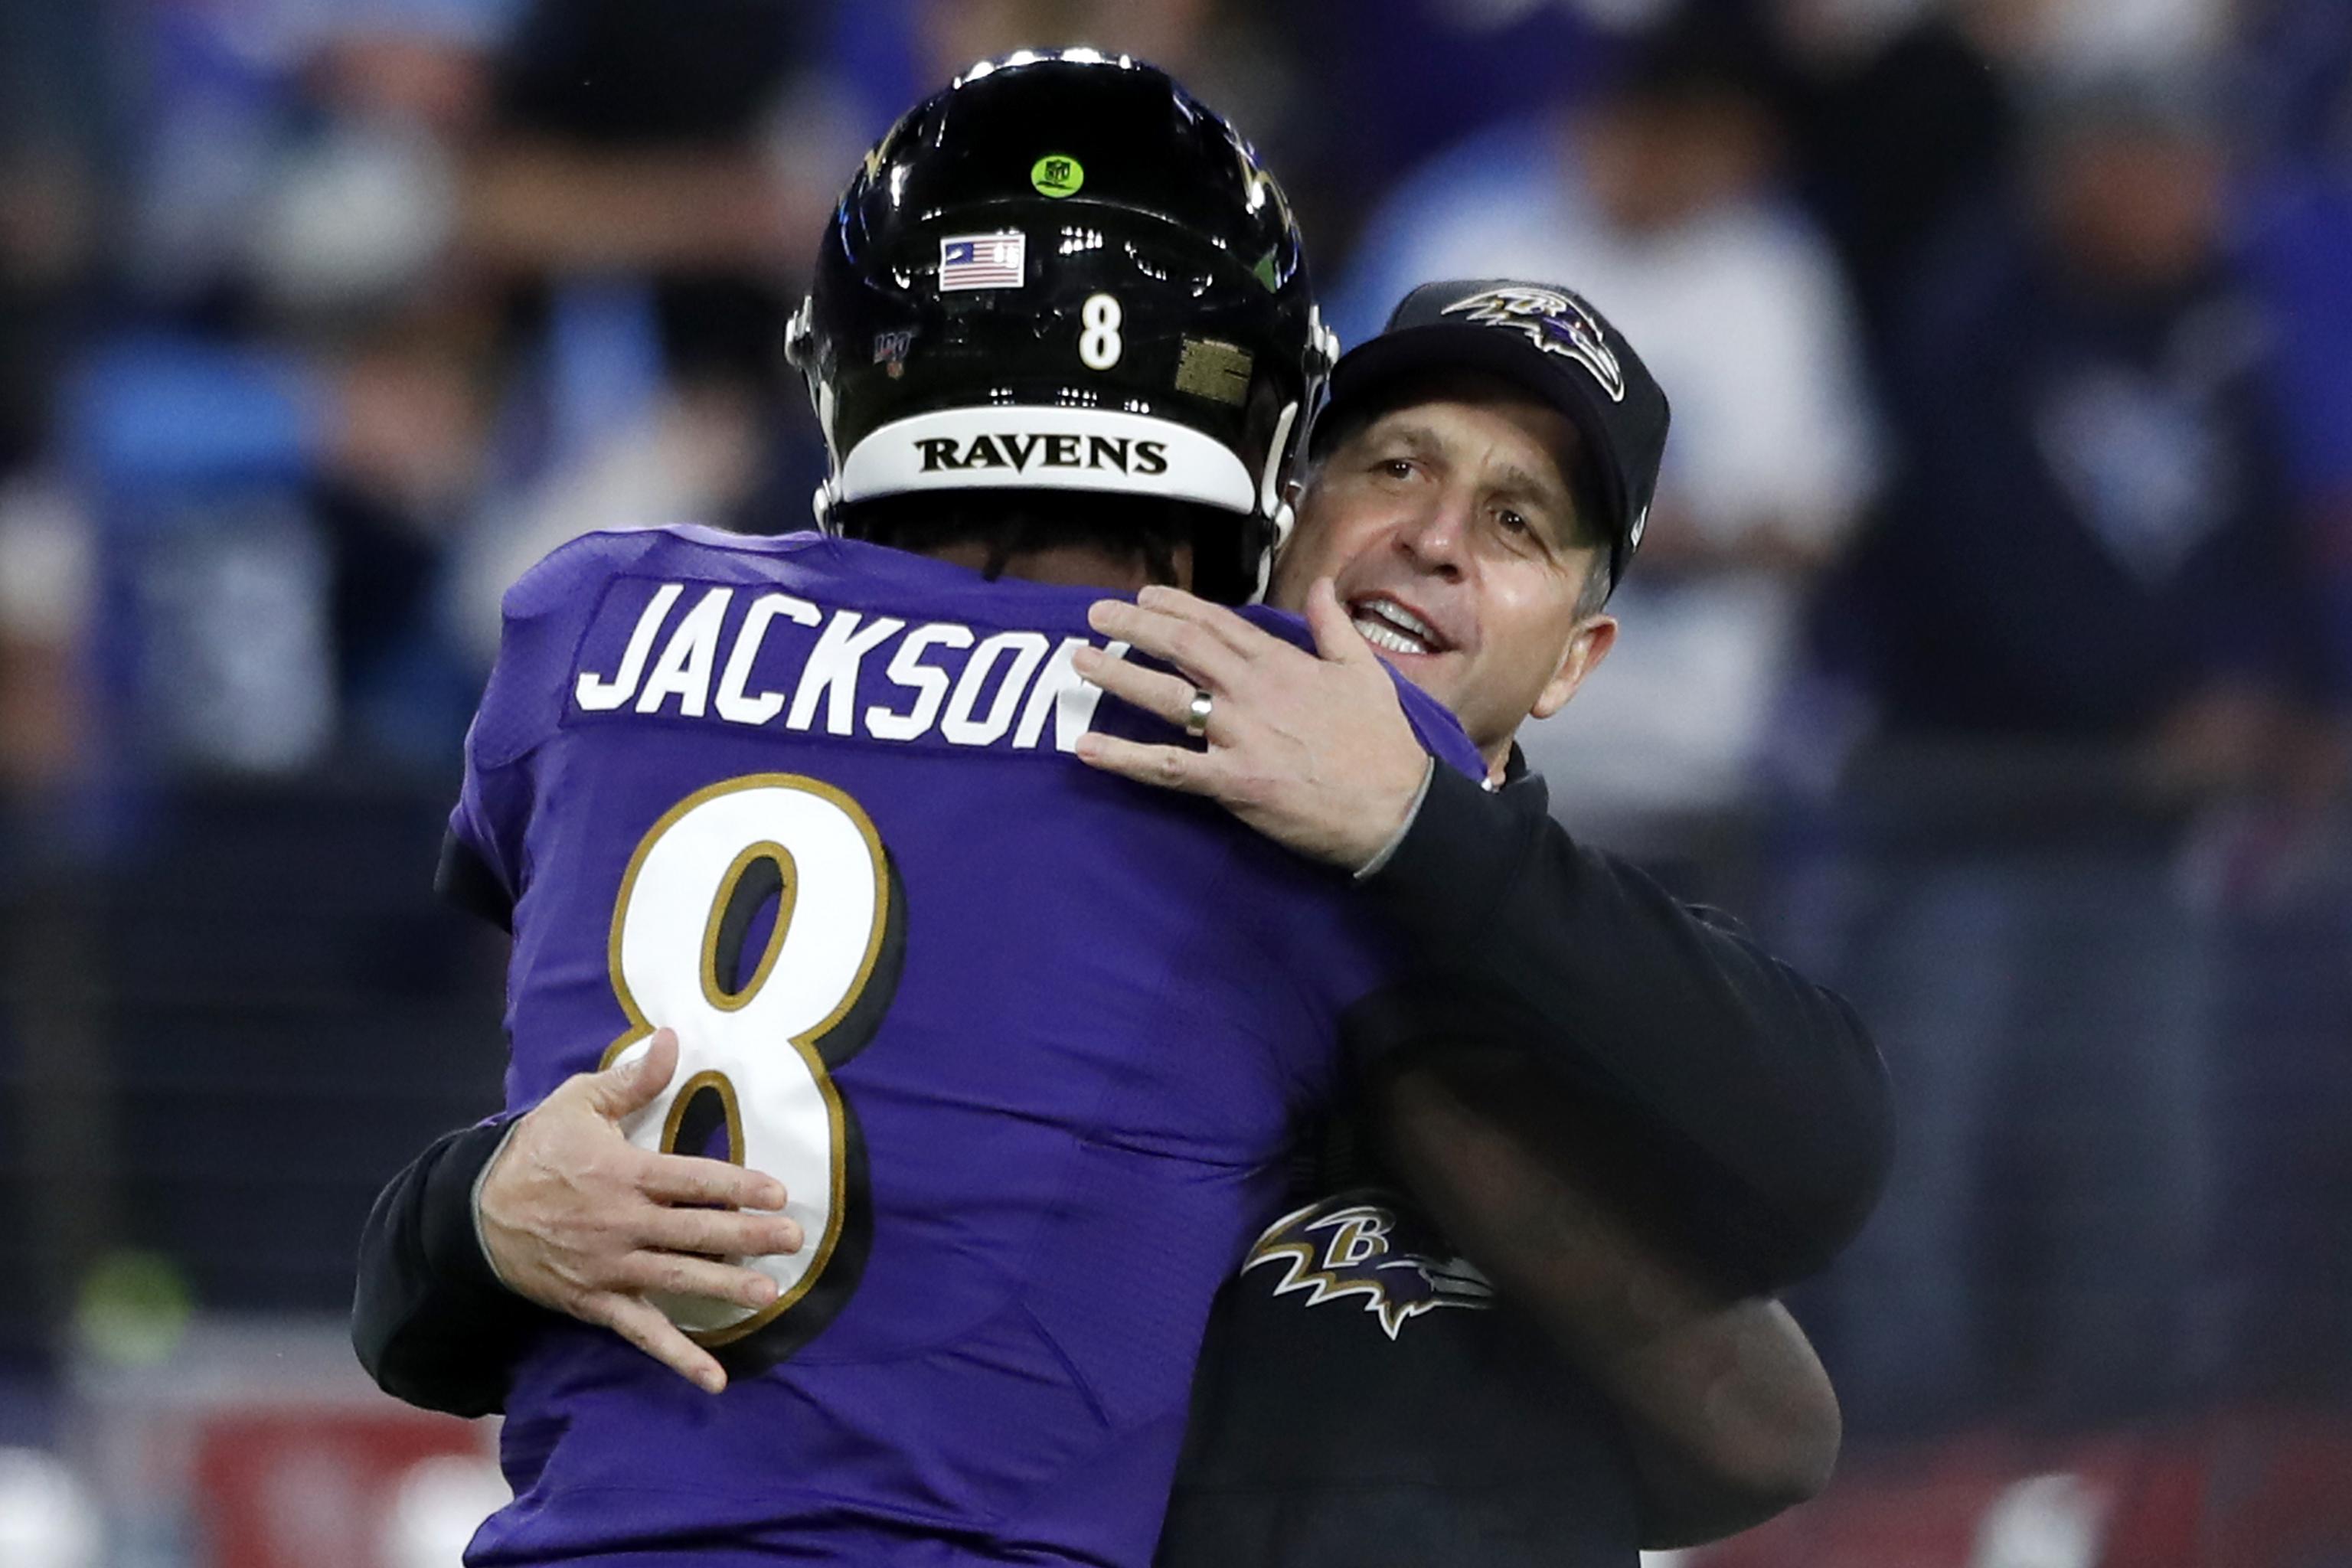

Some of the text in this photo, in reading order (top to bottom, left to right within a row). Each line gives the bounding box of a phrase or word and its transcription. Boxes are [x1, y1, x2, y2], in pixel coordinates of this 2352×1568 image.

[1078, 293, 1122, 371] 8
[913, 434, 1168, 476] RAVENS
[575, 583, 1130, 753] JACKSON
[599, 772, 900, 1359] 8
